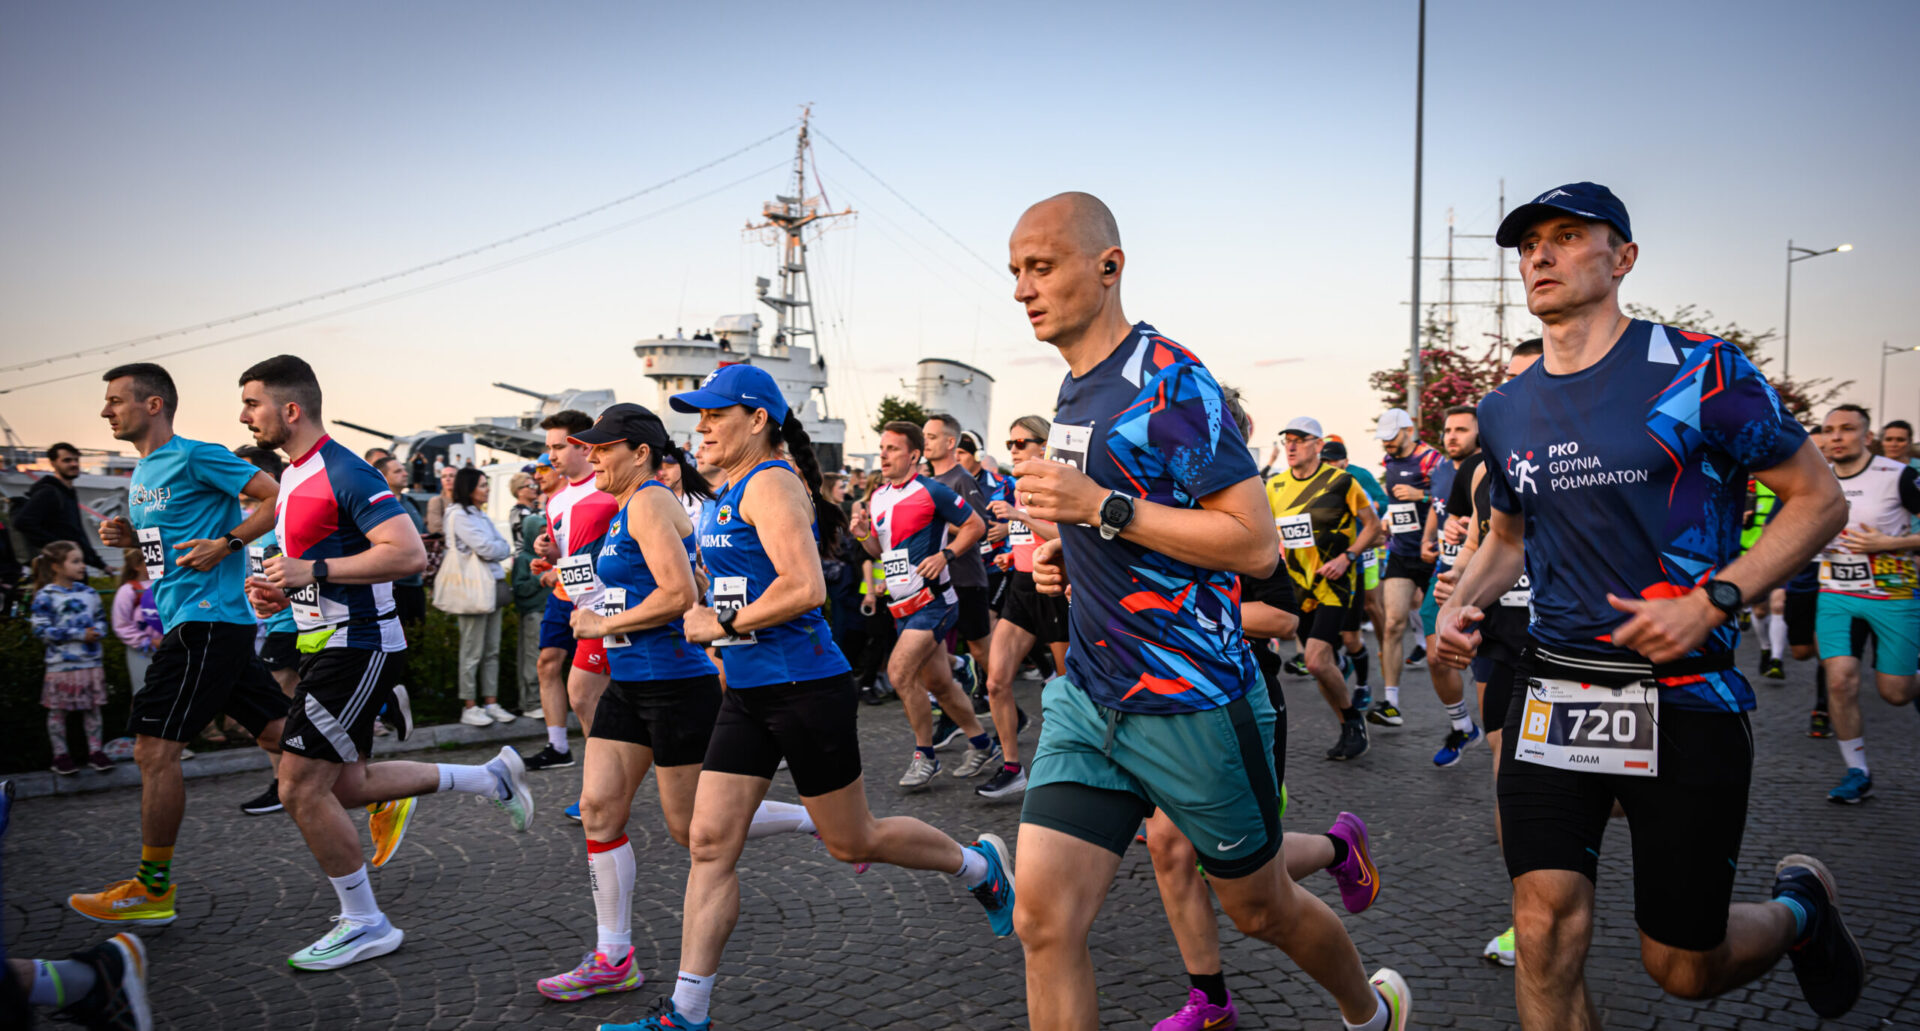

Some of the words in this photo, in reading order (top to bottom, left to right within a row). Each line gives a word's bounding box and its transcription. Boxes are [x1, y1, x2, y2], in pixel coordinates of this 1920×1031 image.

[1548, 441, 1579, 458] PKO
[1548, 455, 1602, 475] GDYNIA
[1550, 469, 1649, 493] PÓŁMARATON
[1282, 524, 1309, 538] 1062
[562, 566, 592, 584] 3065
[1528, 711, 1546, 736] B
[1567, 709, 1637, 743] 720
[1569, 754, 1600, 764] ADAM
